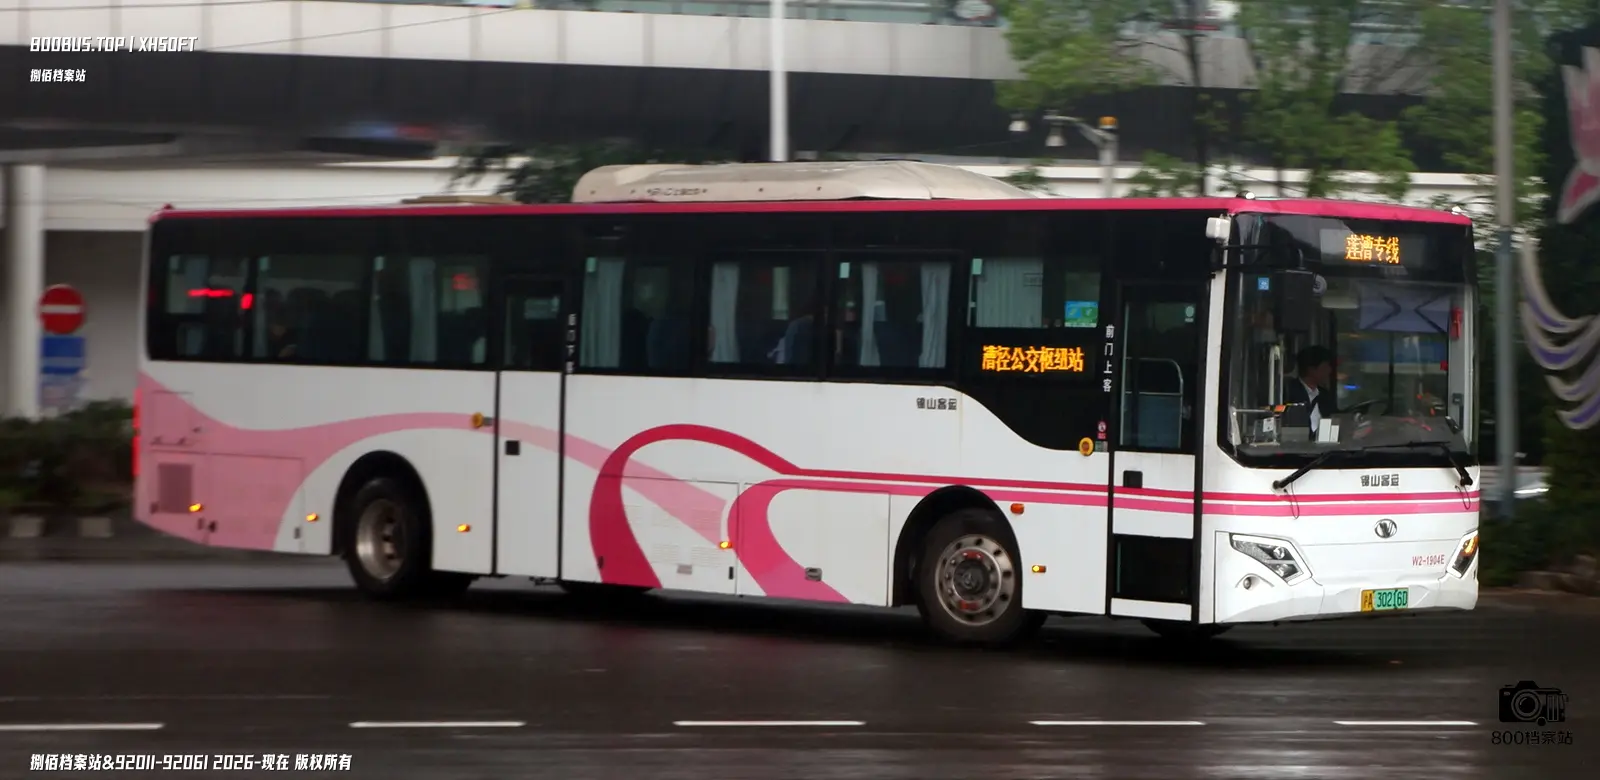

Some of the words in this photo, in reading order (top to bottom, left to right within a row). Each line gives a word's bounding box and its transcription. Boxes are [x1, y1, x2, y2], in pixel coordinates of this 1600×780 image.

[1344, 234, 1400, 264] 莲漕专线
[1103, 324, 1115, 393] 前门上客
[1412, 555, 1445, 566] W2-1904E
